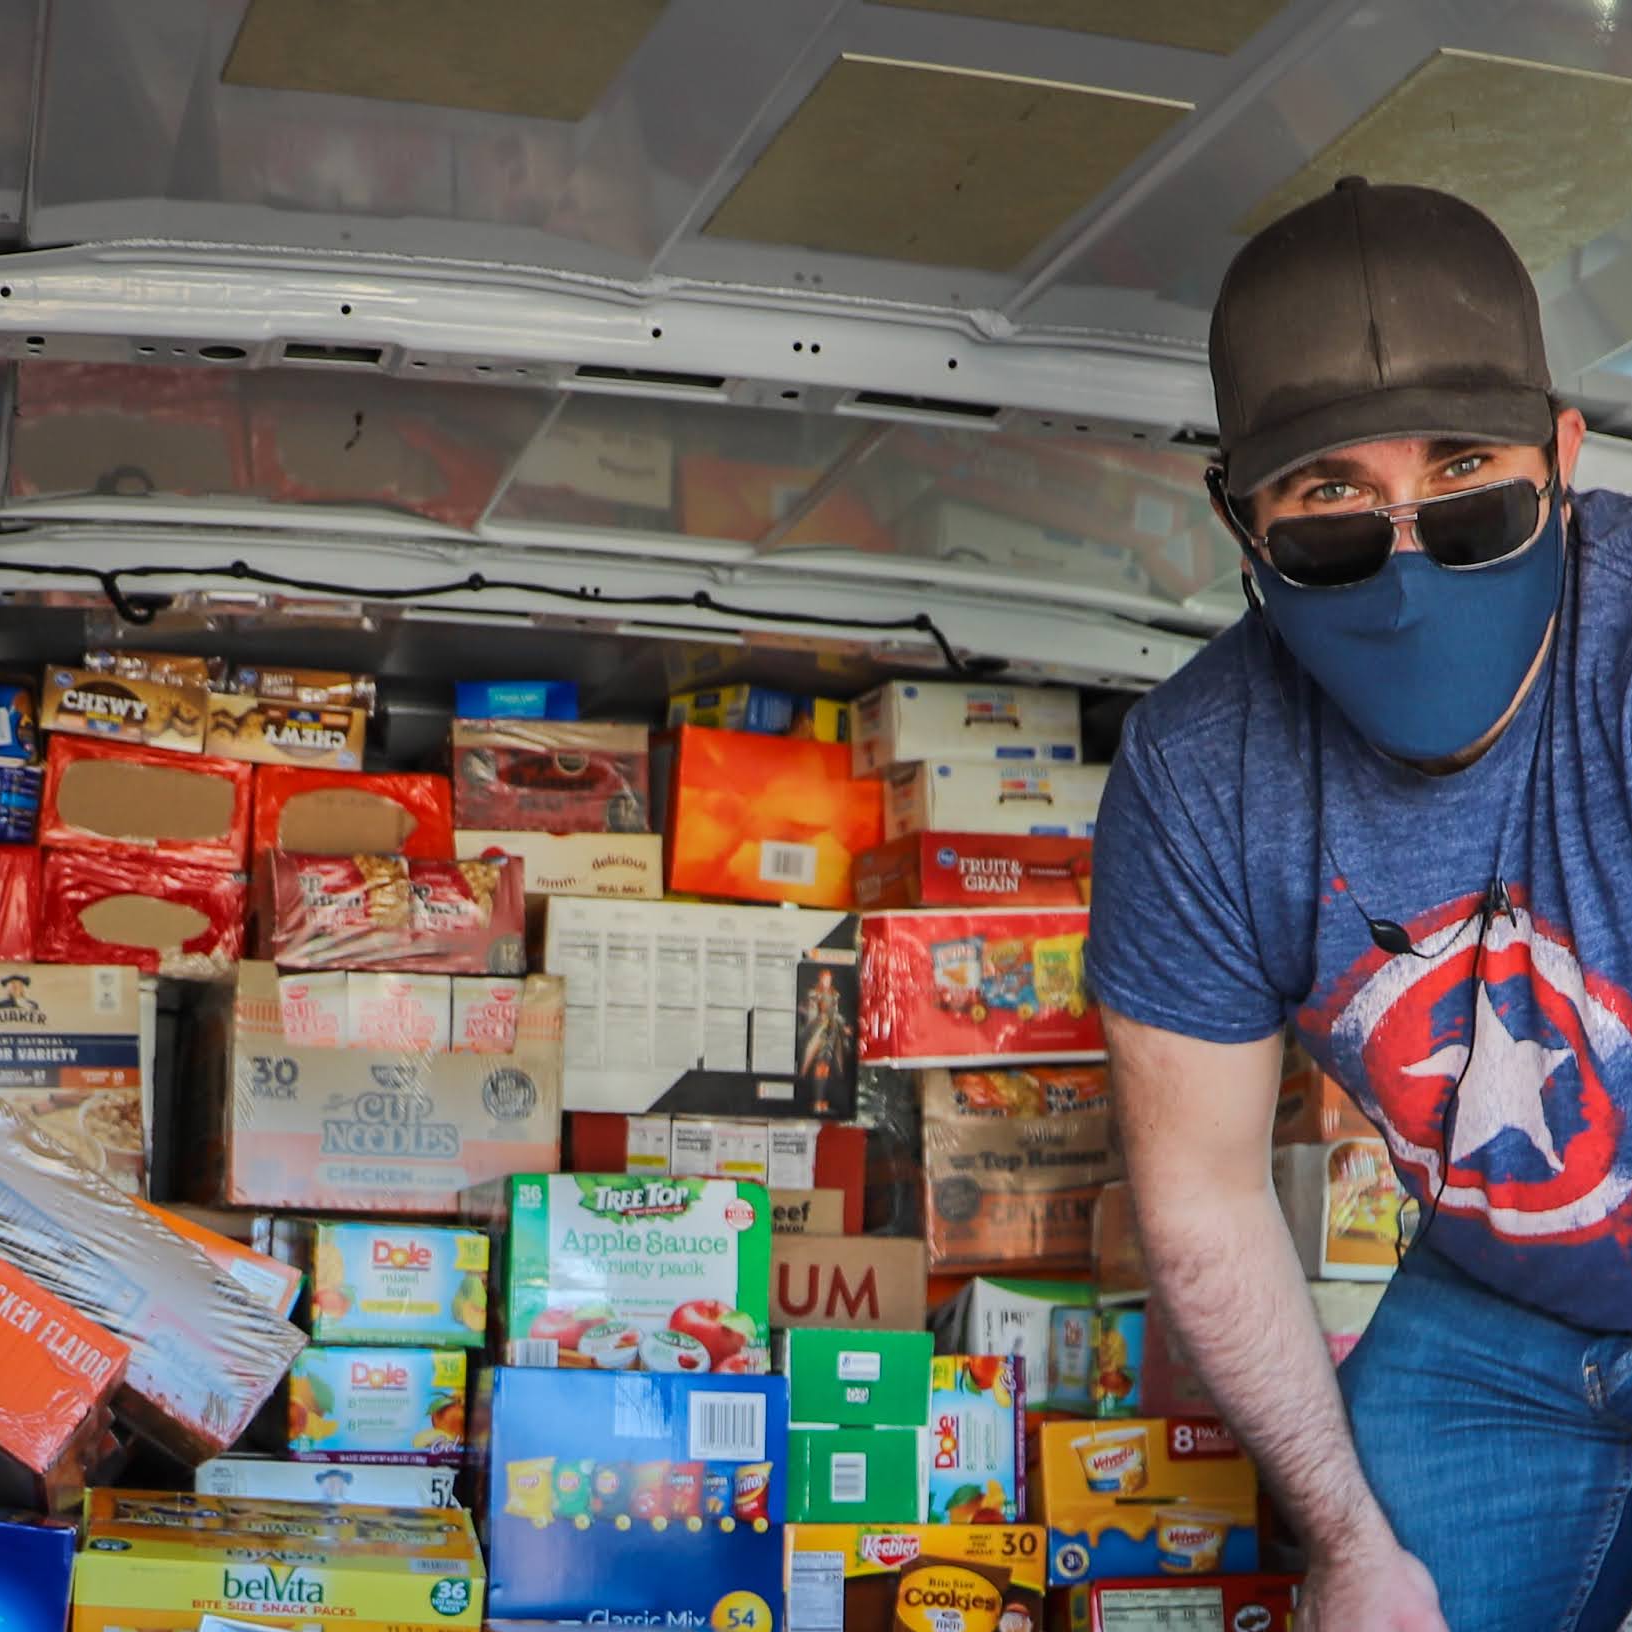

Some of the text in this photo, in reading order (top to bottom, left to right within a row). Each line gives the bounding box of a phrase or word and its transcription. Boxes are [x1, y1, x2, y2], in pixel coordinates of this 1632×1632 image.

[62, 689, 148, 721] CHEWY
[266, 725, 348, 751] CHEWY
[592, 853, 647, 870] delicious
[964, 875, 1018, 892] GRAIN
[14, 1046, 78, 1062] VARIETY
[252, 1057, 299, 1085] 30
[352, 1093, 433, 1127] CUP
[321, 1120, 460, 1158] NOODLES
[982, 1151, 1108, 1171] Top Ramen
[327, 1167, 414, 1184] CHICKEN
[519, 1184, 542, 1201] 36
[595, 1182, 692, 1208] TREE TOP
[372, 1239, 432, 1269] Dole
[560, 1228, 728, 1258] Apple Sauce
[778, 1263, 880, 1321] UM
[36, 1319, 113, 1386] FLAVOR
[351, 1361, 408, 1389] Dole
[935, 1415, 956, 1469] Dole
[1173, 1425, 1195, 1453] 8
[1093, 1446, 1135, 1472] Velveeta
[862, 1533, 920, 1559] Keebler
[1001, 1532, 1037, 1555] 30
[1167, 1528, 1215, 1546] Velveeta
[223, 1567, 324, 1603] belVita
[438, 1581, 466, 1599] 36
[192, 1600, 357, 1617] BITE SIZE SNACK PACKS
[904, 1587, 1000, 1612] Cookies
[727, 1608, 757, 1629] 54
